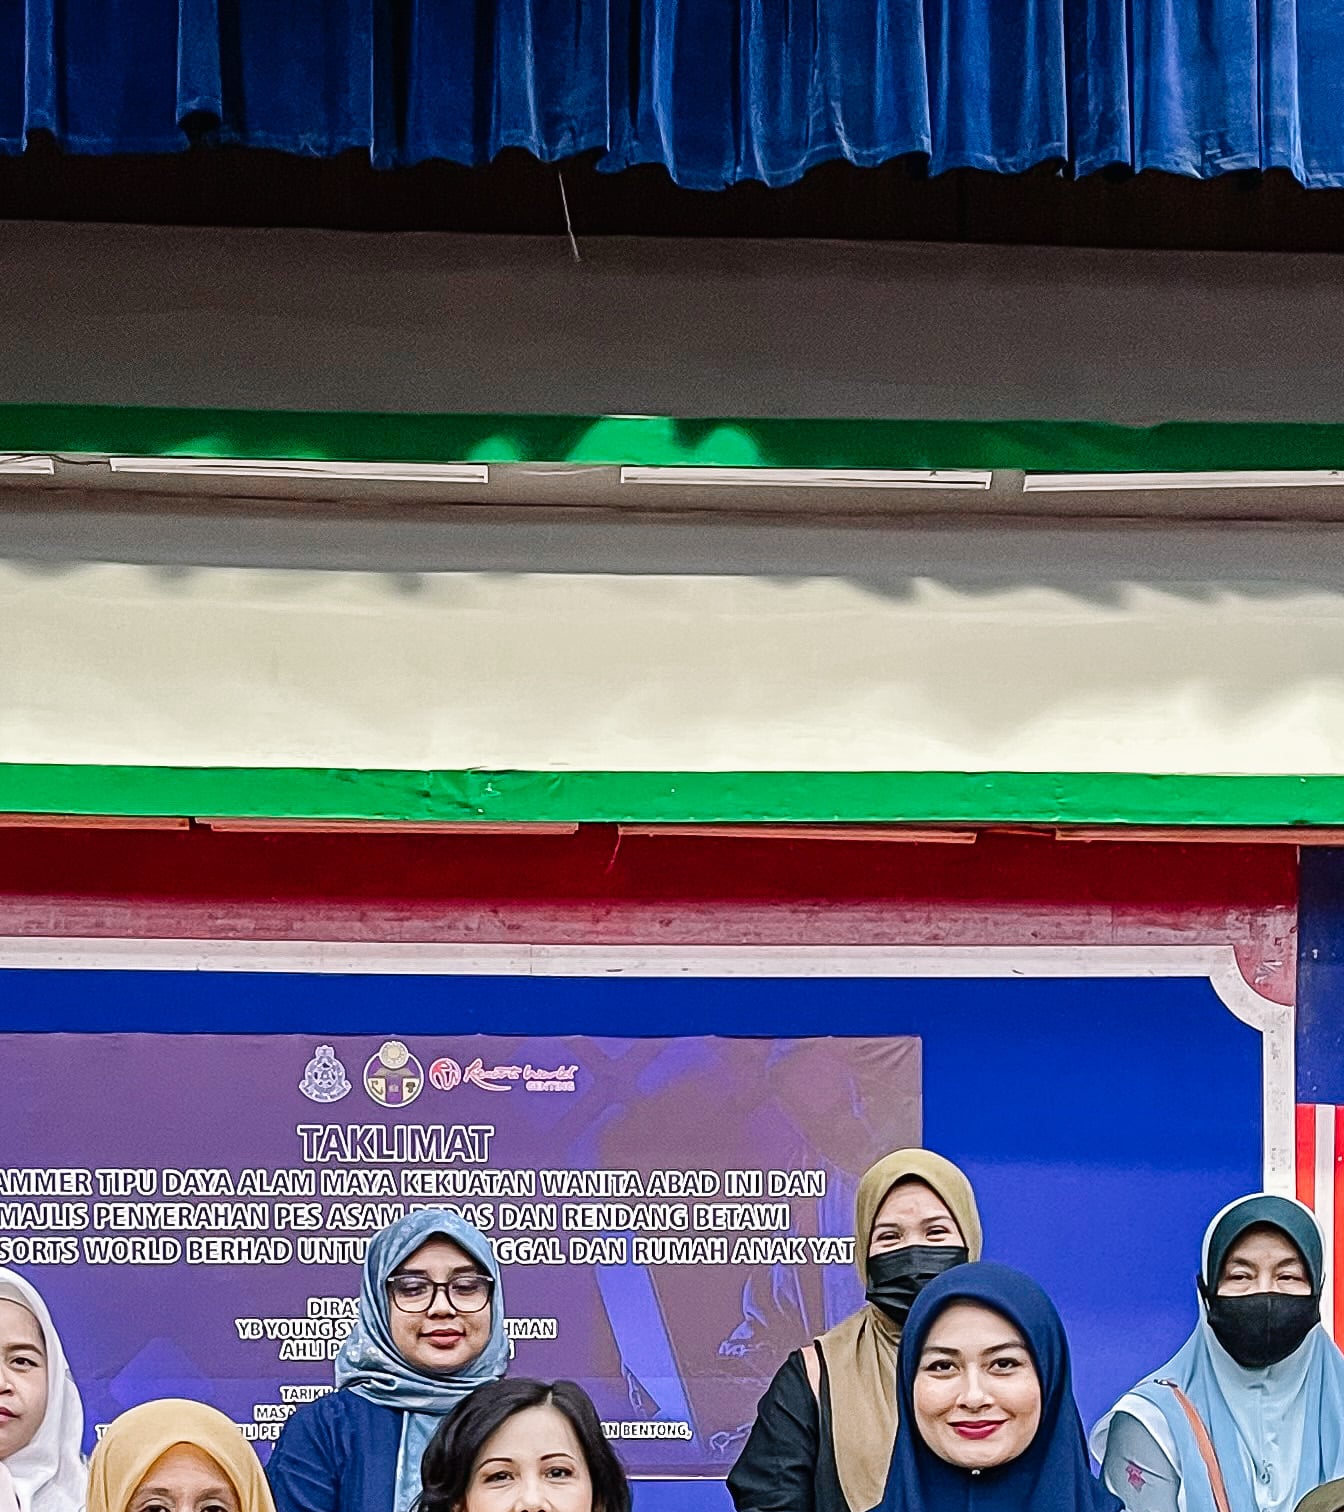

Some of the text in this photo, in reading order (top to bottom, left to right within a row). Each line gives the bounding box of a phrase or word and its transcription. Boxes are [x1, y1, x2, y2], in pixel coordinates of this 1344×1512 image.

[298, 1126, 494, 1162] TAKLIMAT
[97, 1170, 156, 1194] TIPU
[164, 1170, 234, 1194] DAYA
[240, 1170, 314, 1194] ALAM
[323, 1171, 396, 1195] MAYA
[404, 1171, 535, 1195] KEKUATAN
[542, 1171, 643, 1195] WANITA
[648, 1171, 719, 1195] ABAD
[725, 1171, 762, 1195] INI
[769, 1171, 825, 1195] DAN
[95, 1204, 267, 1229] PENYERAHAN
[275, 1204, 323, 1229] PES
[327, 1204, 403, 1229] ASAM
[500, 1204, 554, 1229] DAN
[563, 1204, 687, 1229] RENDANG
[694, 1204, 789, 1229] BETAWI
[84, 1238, 180, 1263] WORLD
[187, 1238, 291, 1263] BERHAD
[299, 1238, 367, 1263] UNTU
[489, 1238, 565, 1263] GGAL
[571, 1238, 626, 1263] DAN
[634, 1238, 727, 1263] RUMAH
[732, 1238, 807, 1263] ANAK
[809, 1238, 855, 1263] YAT
[237, 1320, 262, 1337] YB
[265, 1320, 332, 1338] YOUNG
[281, 1341, 324, 1359] AHLI
